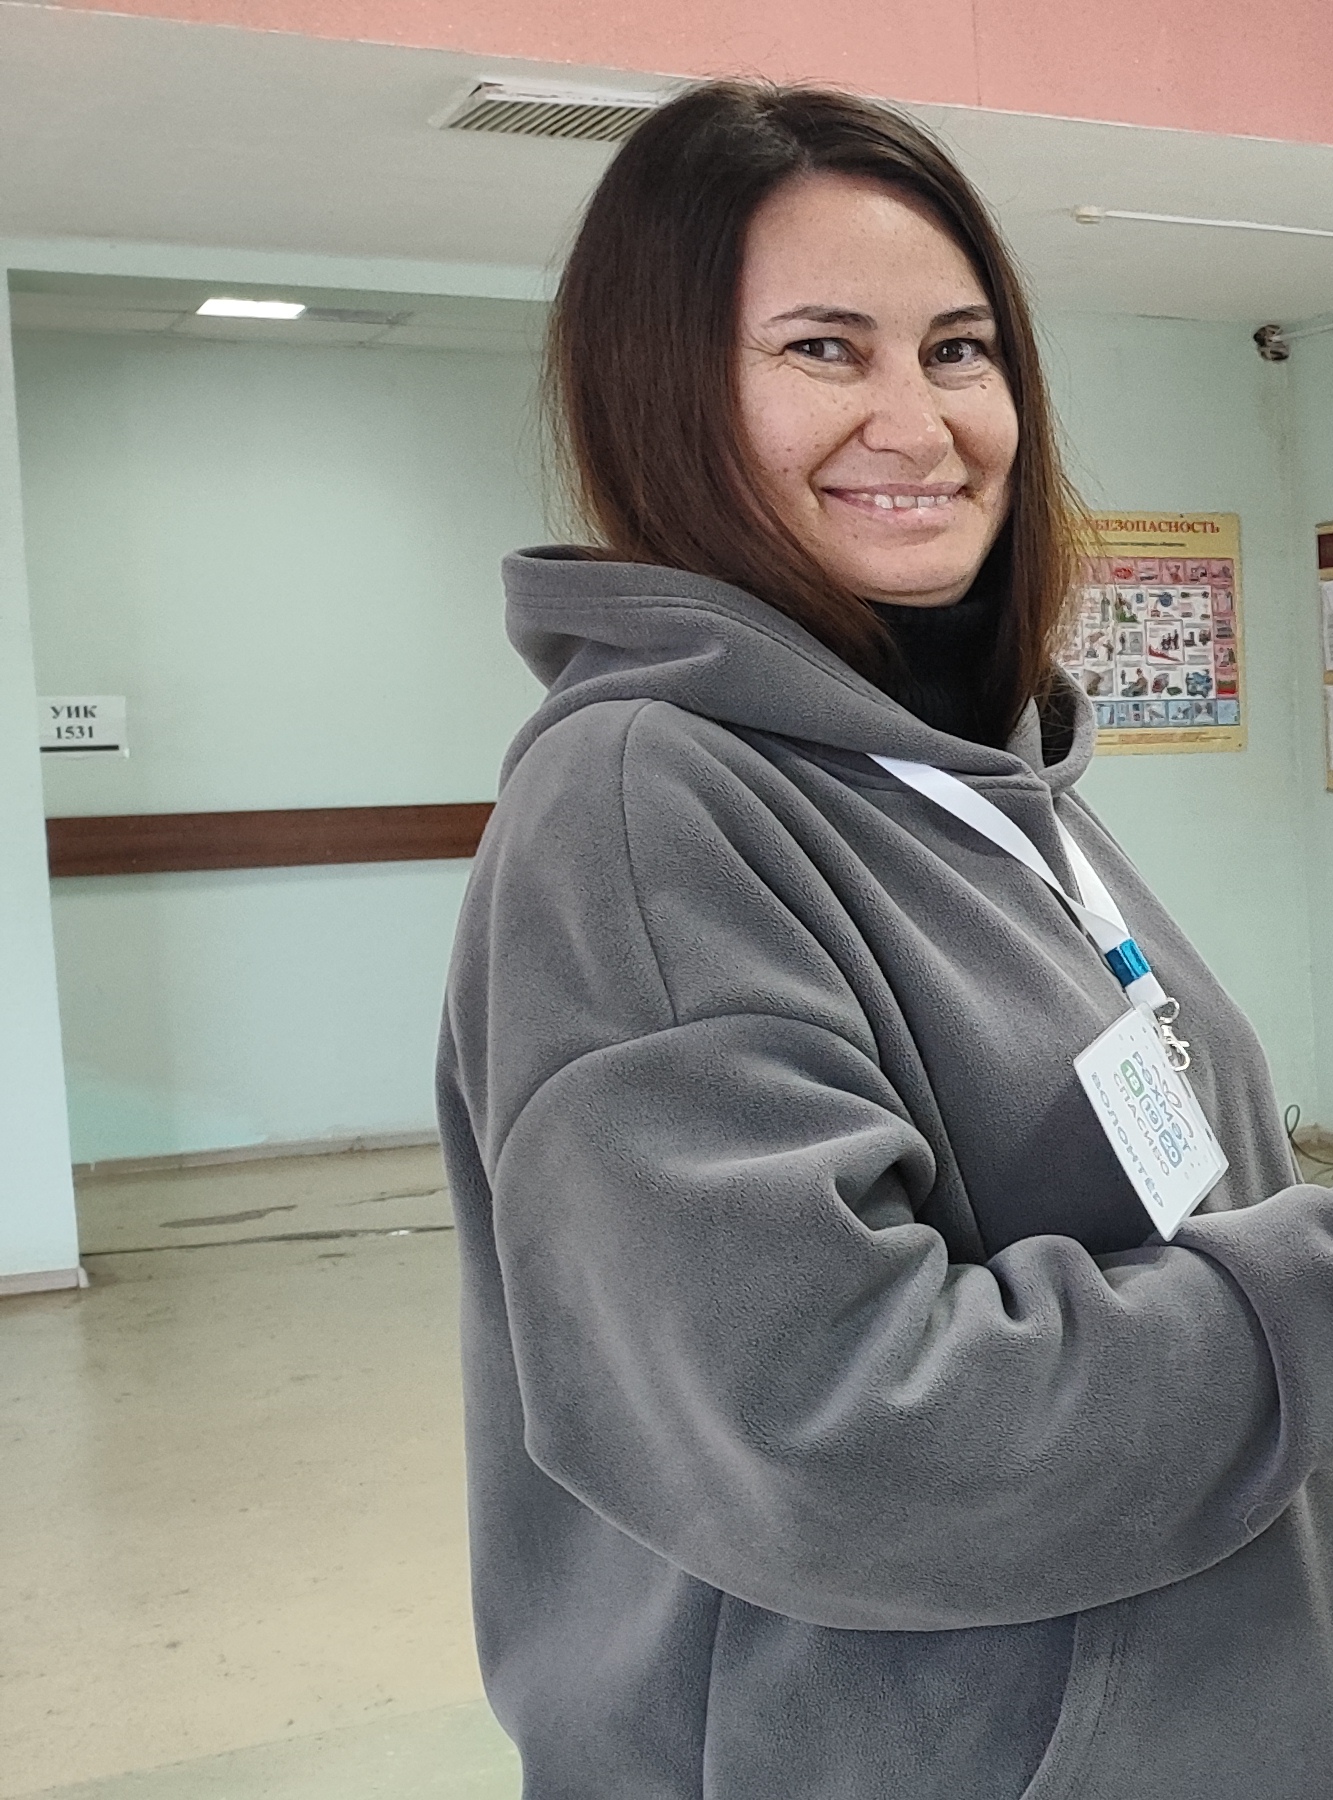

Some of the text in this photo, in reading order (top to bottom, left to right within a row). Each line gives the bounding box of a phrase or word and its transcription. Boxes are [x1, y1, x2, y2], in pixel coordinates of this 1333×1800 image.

[50, 705, 97, 719] УИК
[56, 725, 93, 739] 1531
[1113, 1072, 1170, 1176] СПАСИБО
[1162, 1133, 1178, 1160] 20
